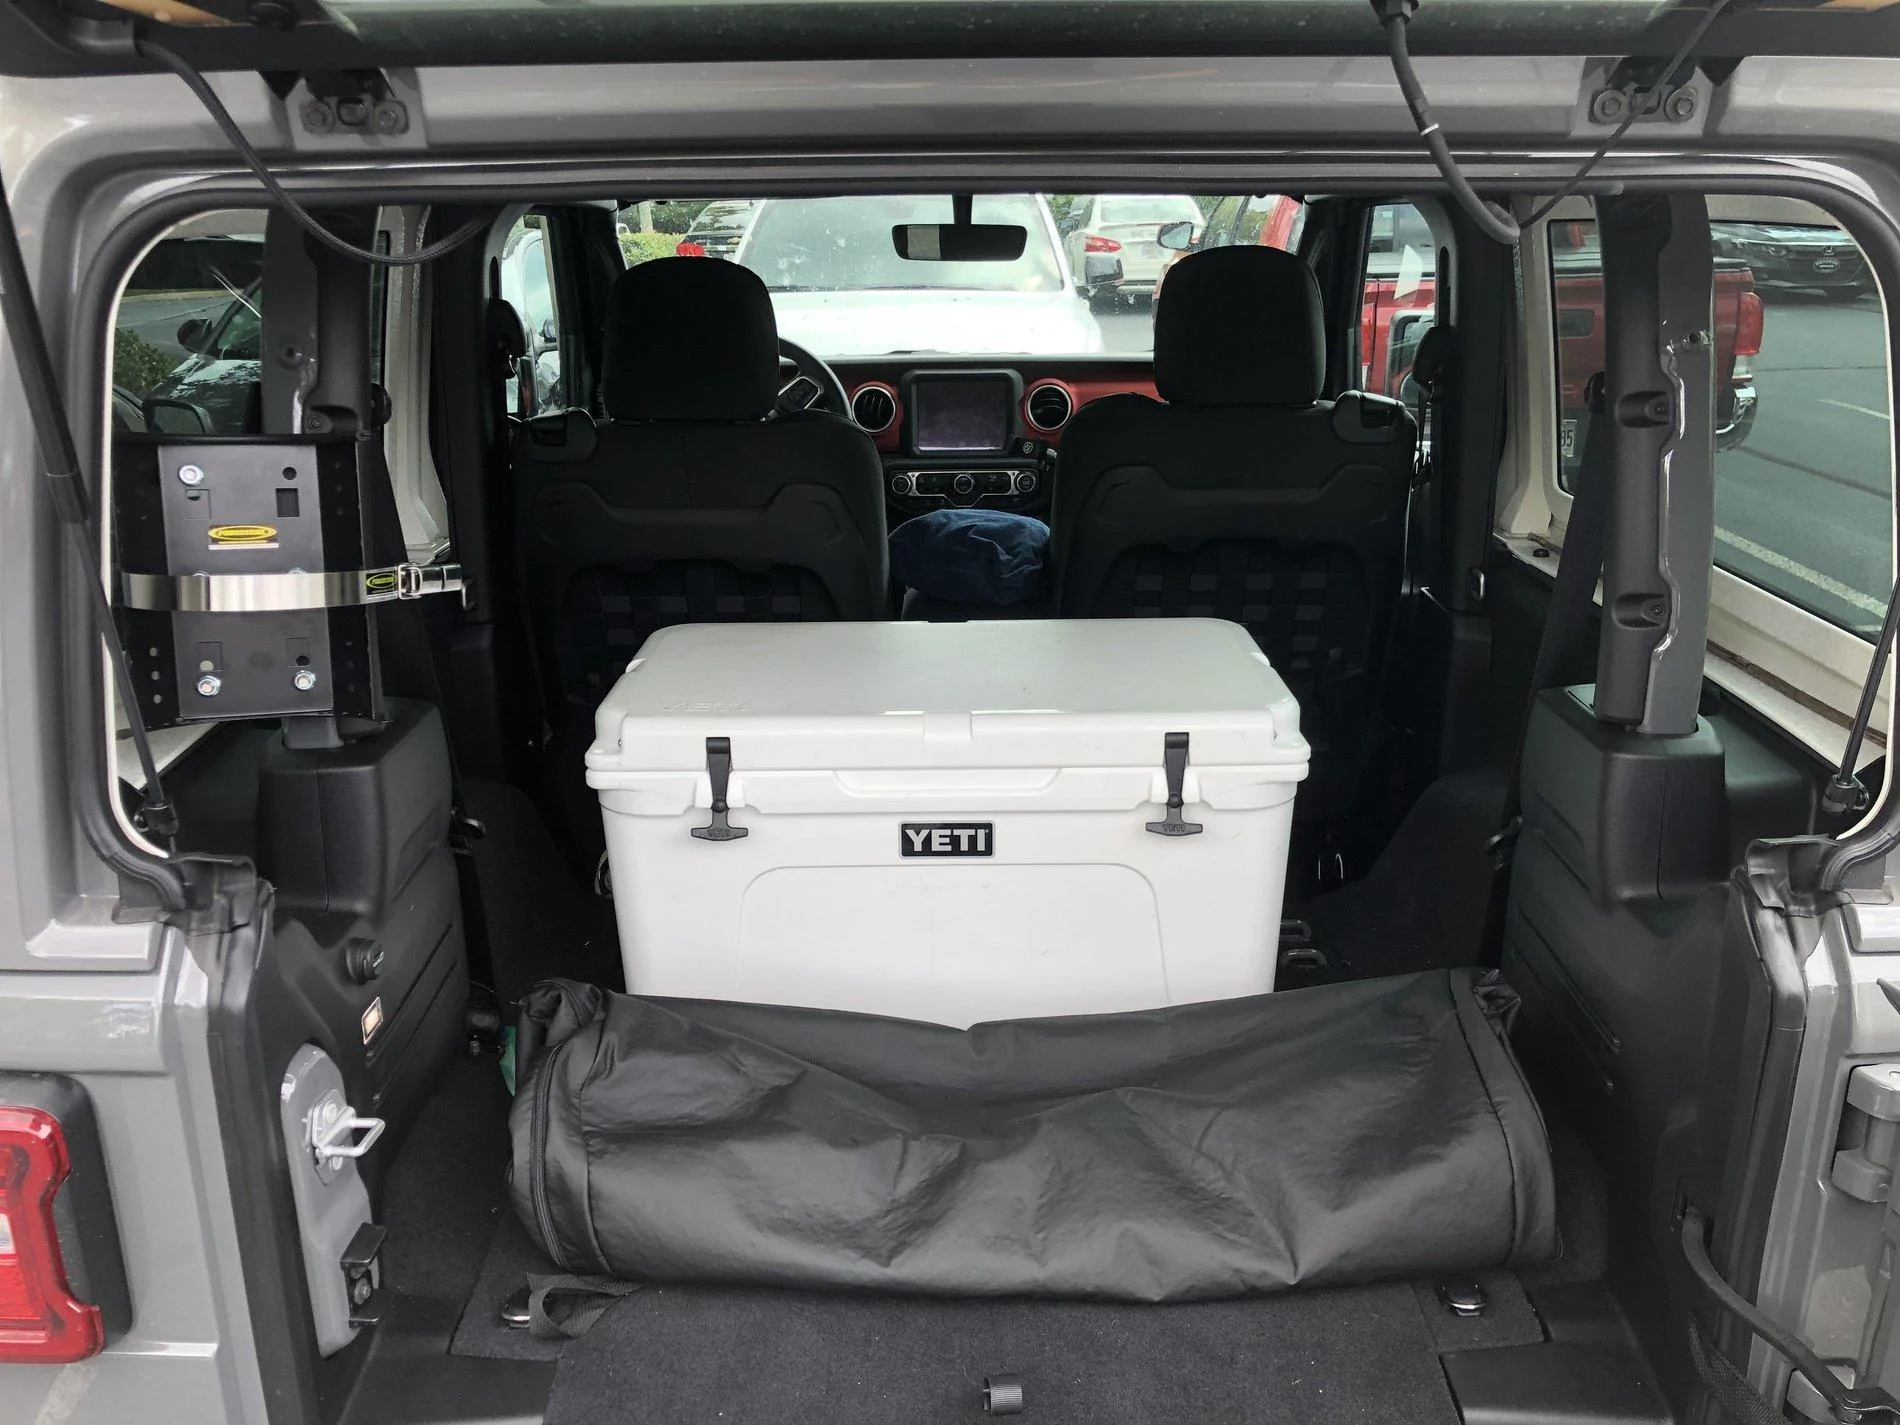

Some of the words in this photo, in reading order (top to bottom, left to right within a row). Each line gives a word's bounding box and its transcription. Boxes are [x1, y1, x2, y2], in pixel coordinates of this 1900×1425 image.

[707, 828, 731, 838] YETI
[1163, 824, 1185, 833] YETI
[905, 829, 988, 852] YETI
